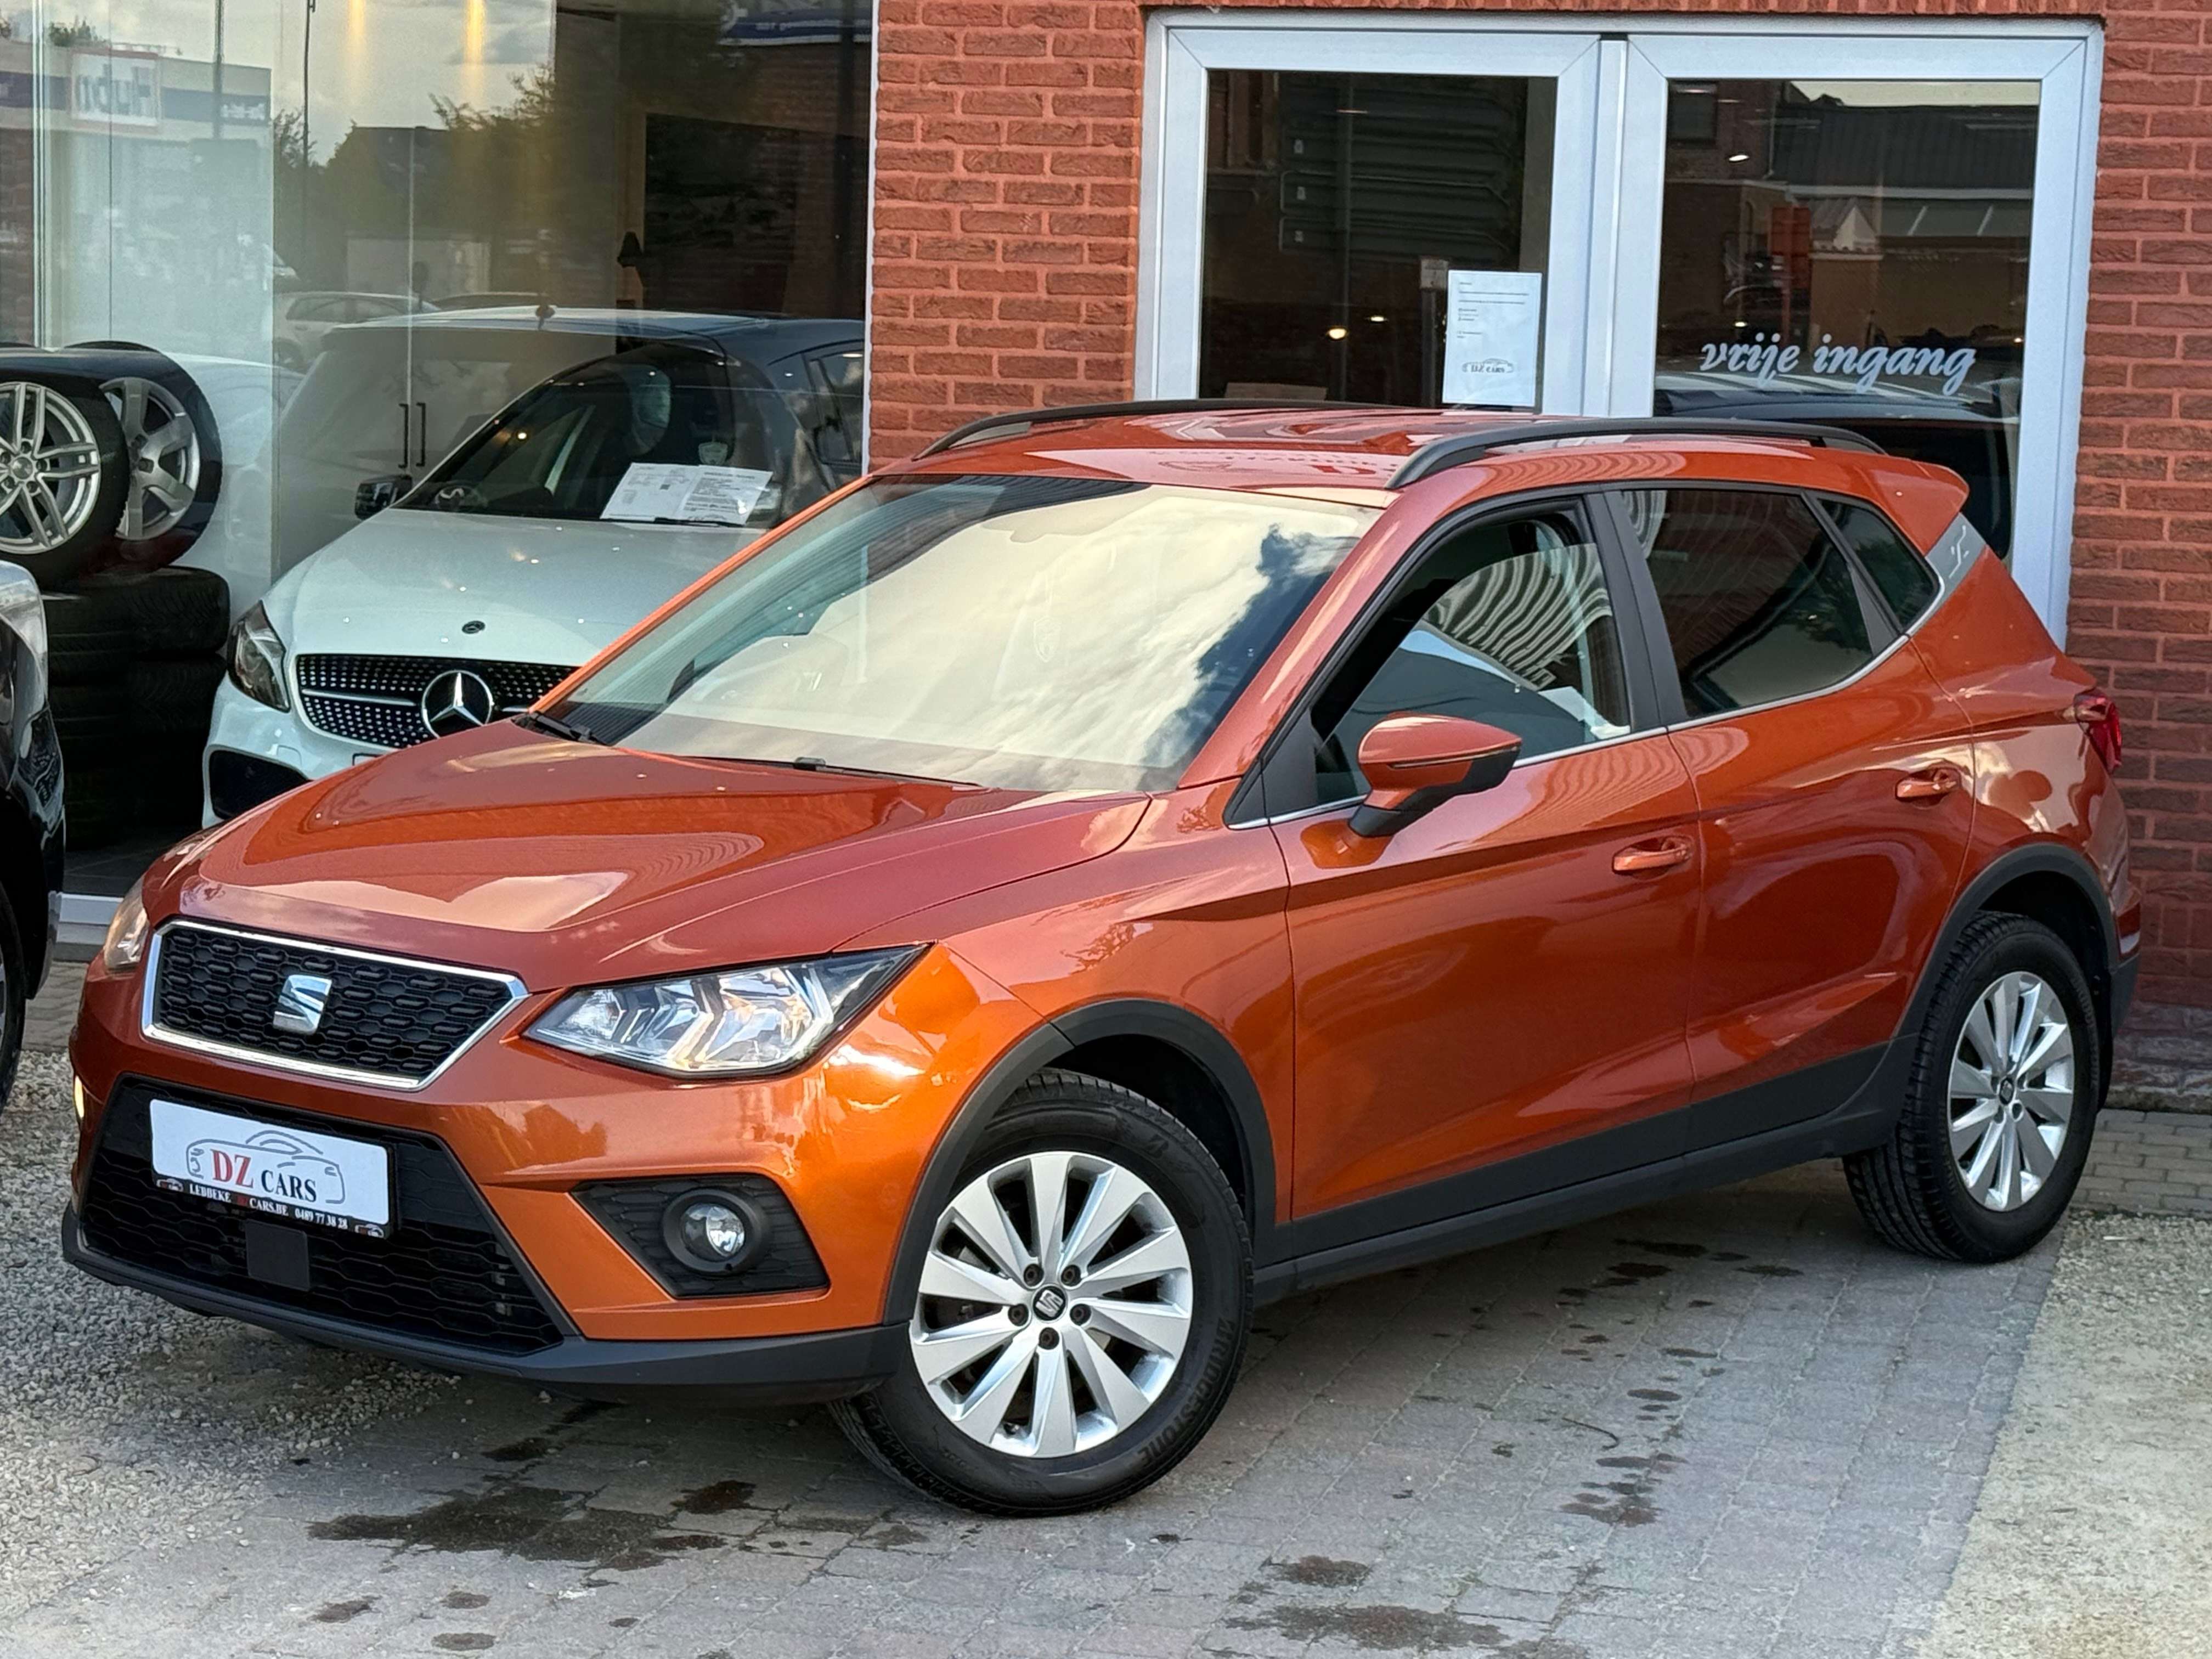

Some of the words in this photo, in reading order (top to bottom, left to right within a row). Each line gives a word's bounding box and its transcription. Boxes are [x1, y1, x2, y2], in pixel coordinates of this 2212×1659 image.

[1700, 332, 1801, 388] vrije
[1813, 333, 1976, 396] ingang
[211, 1149, 253, 1189] DZ
[261, 1170, 317, 1203] CARS
[315, 1212, 325, 1224] 77
[1137, 1318, 1235, 1467] BRIDGESTONE
